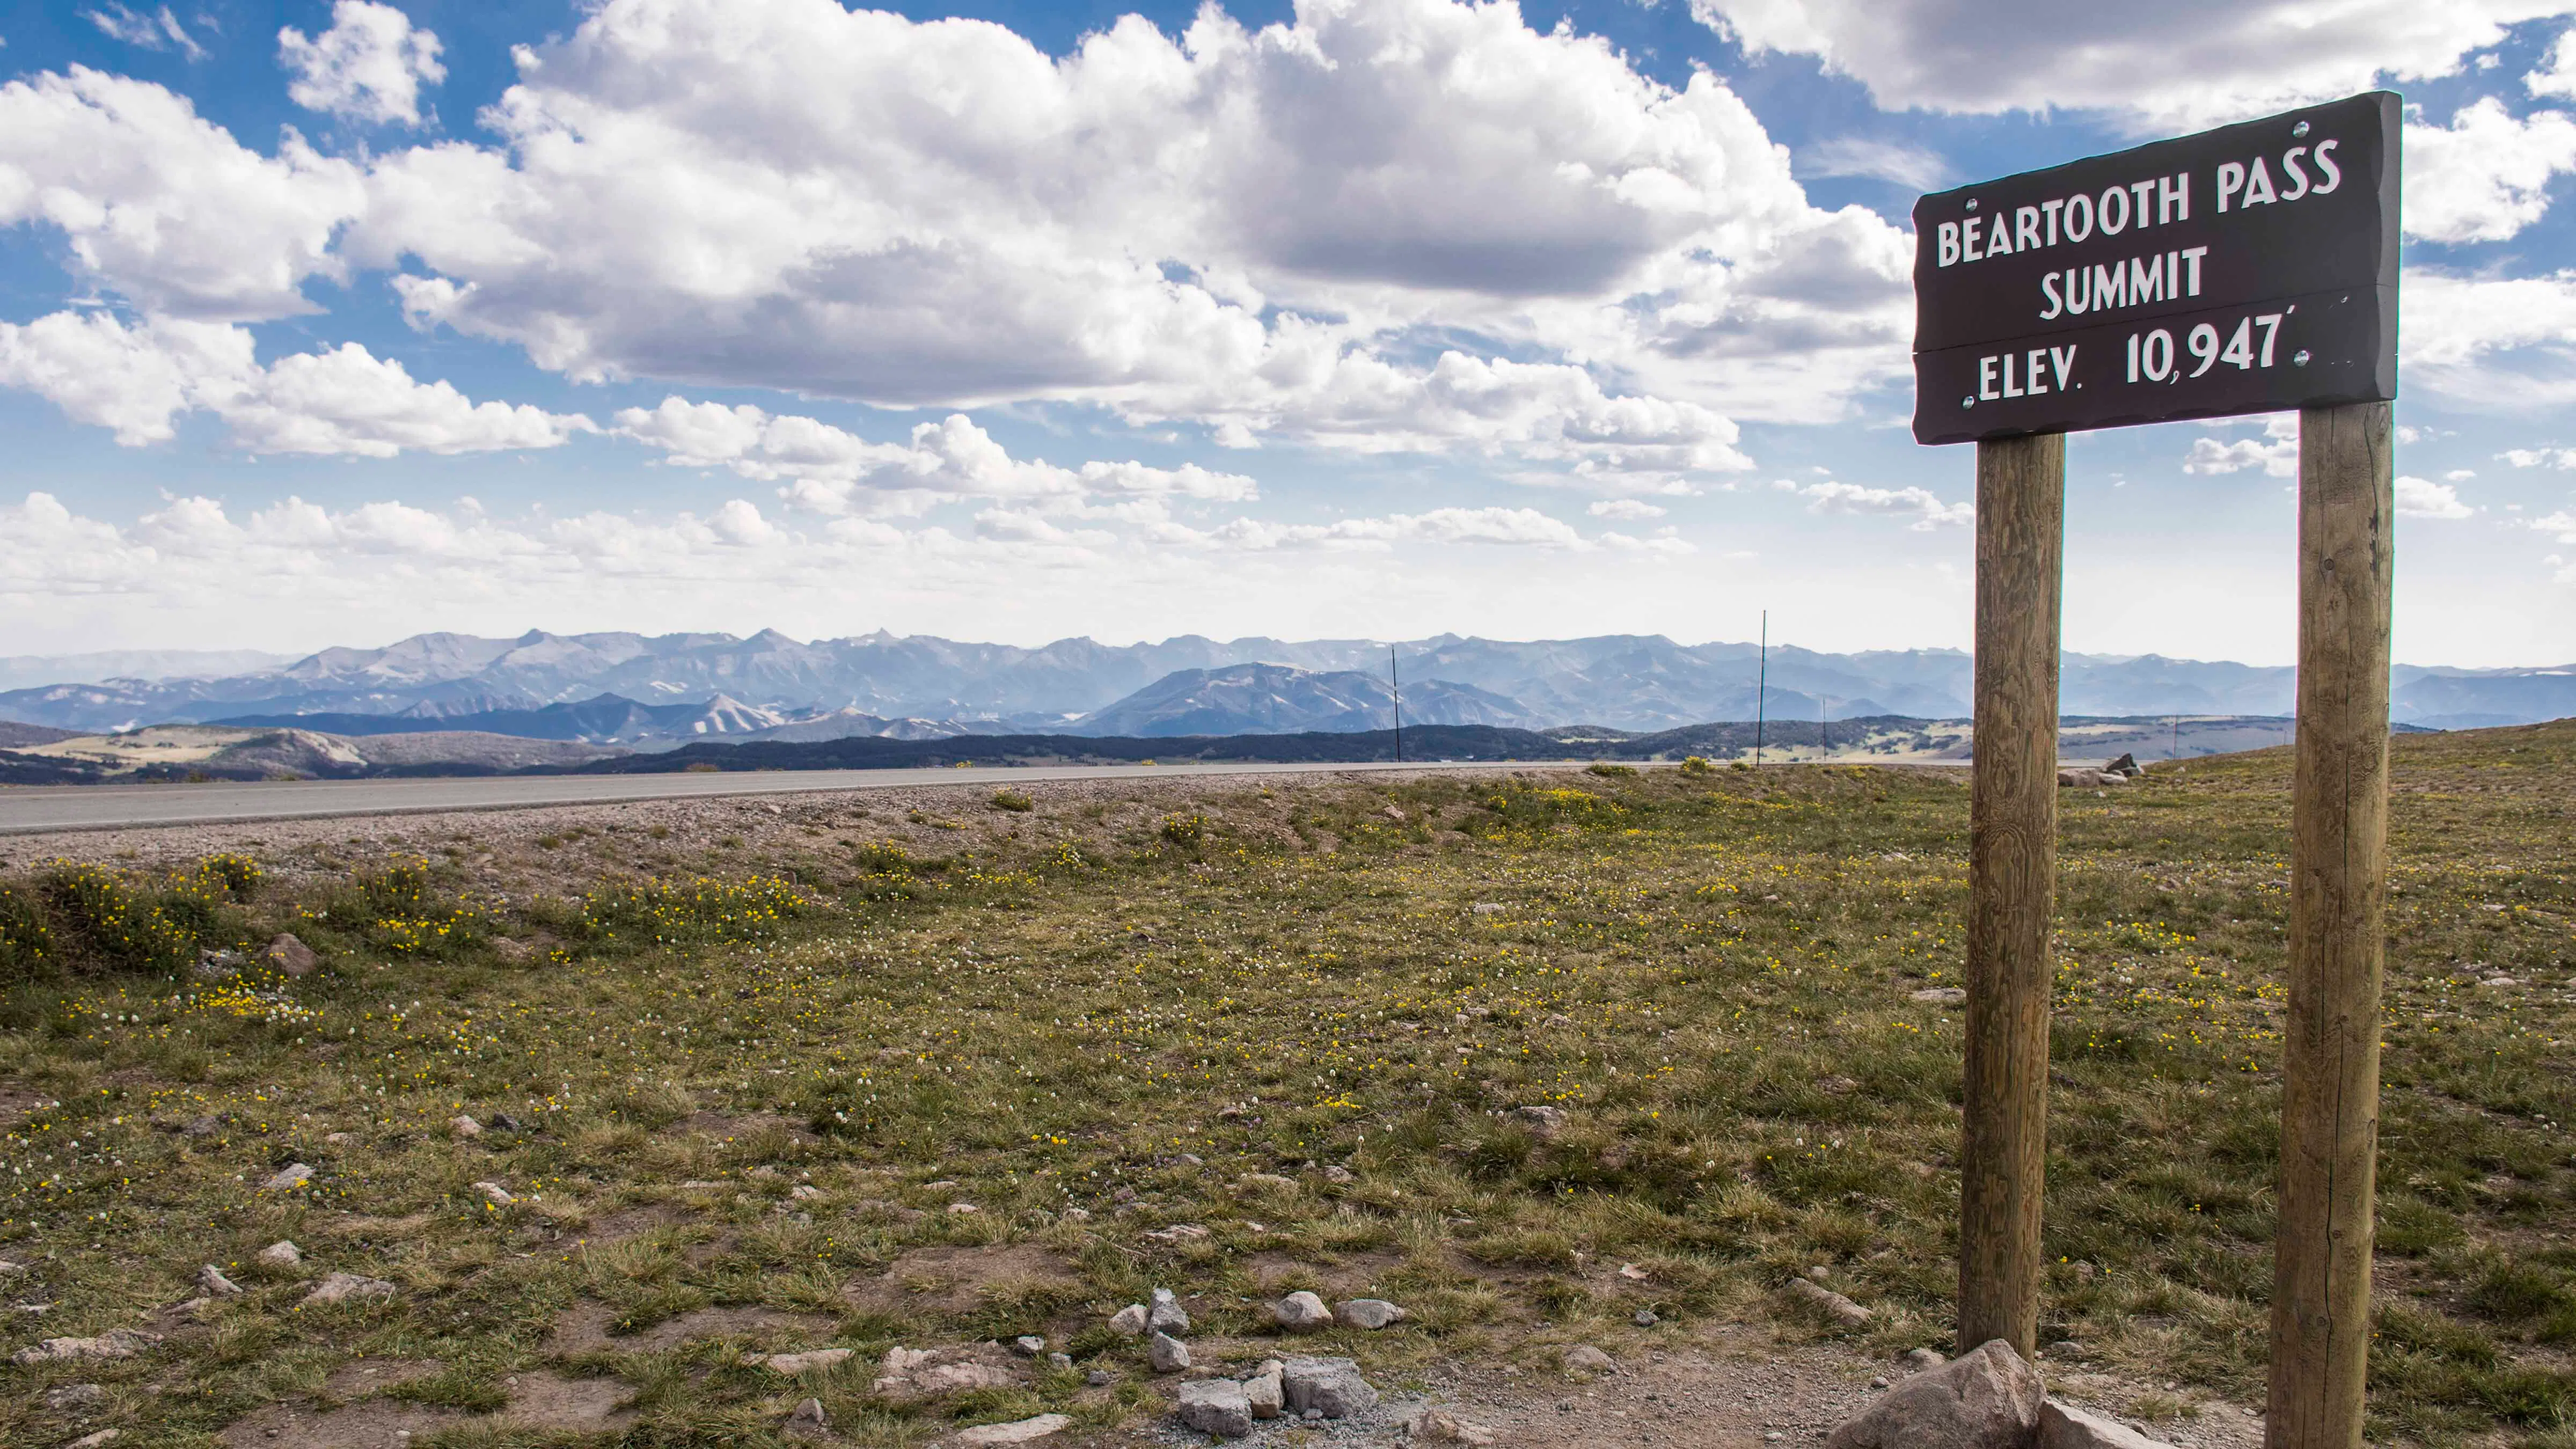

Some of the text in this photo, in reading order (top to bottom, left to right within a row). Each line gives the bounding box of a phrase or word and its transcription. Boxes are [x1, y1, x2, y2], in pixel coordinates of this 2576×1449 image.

[1938, 139, 2341, 267] BEARTOOTH PASS
[2039, 246, 2207, 320] SUMMIT
[1979, 345, 2082, 401] ELEV.
